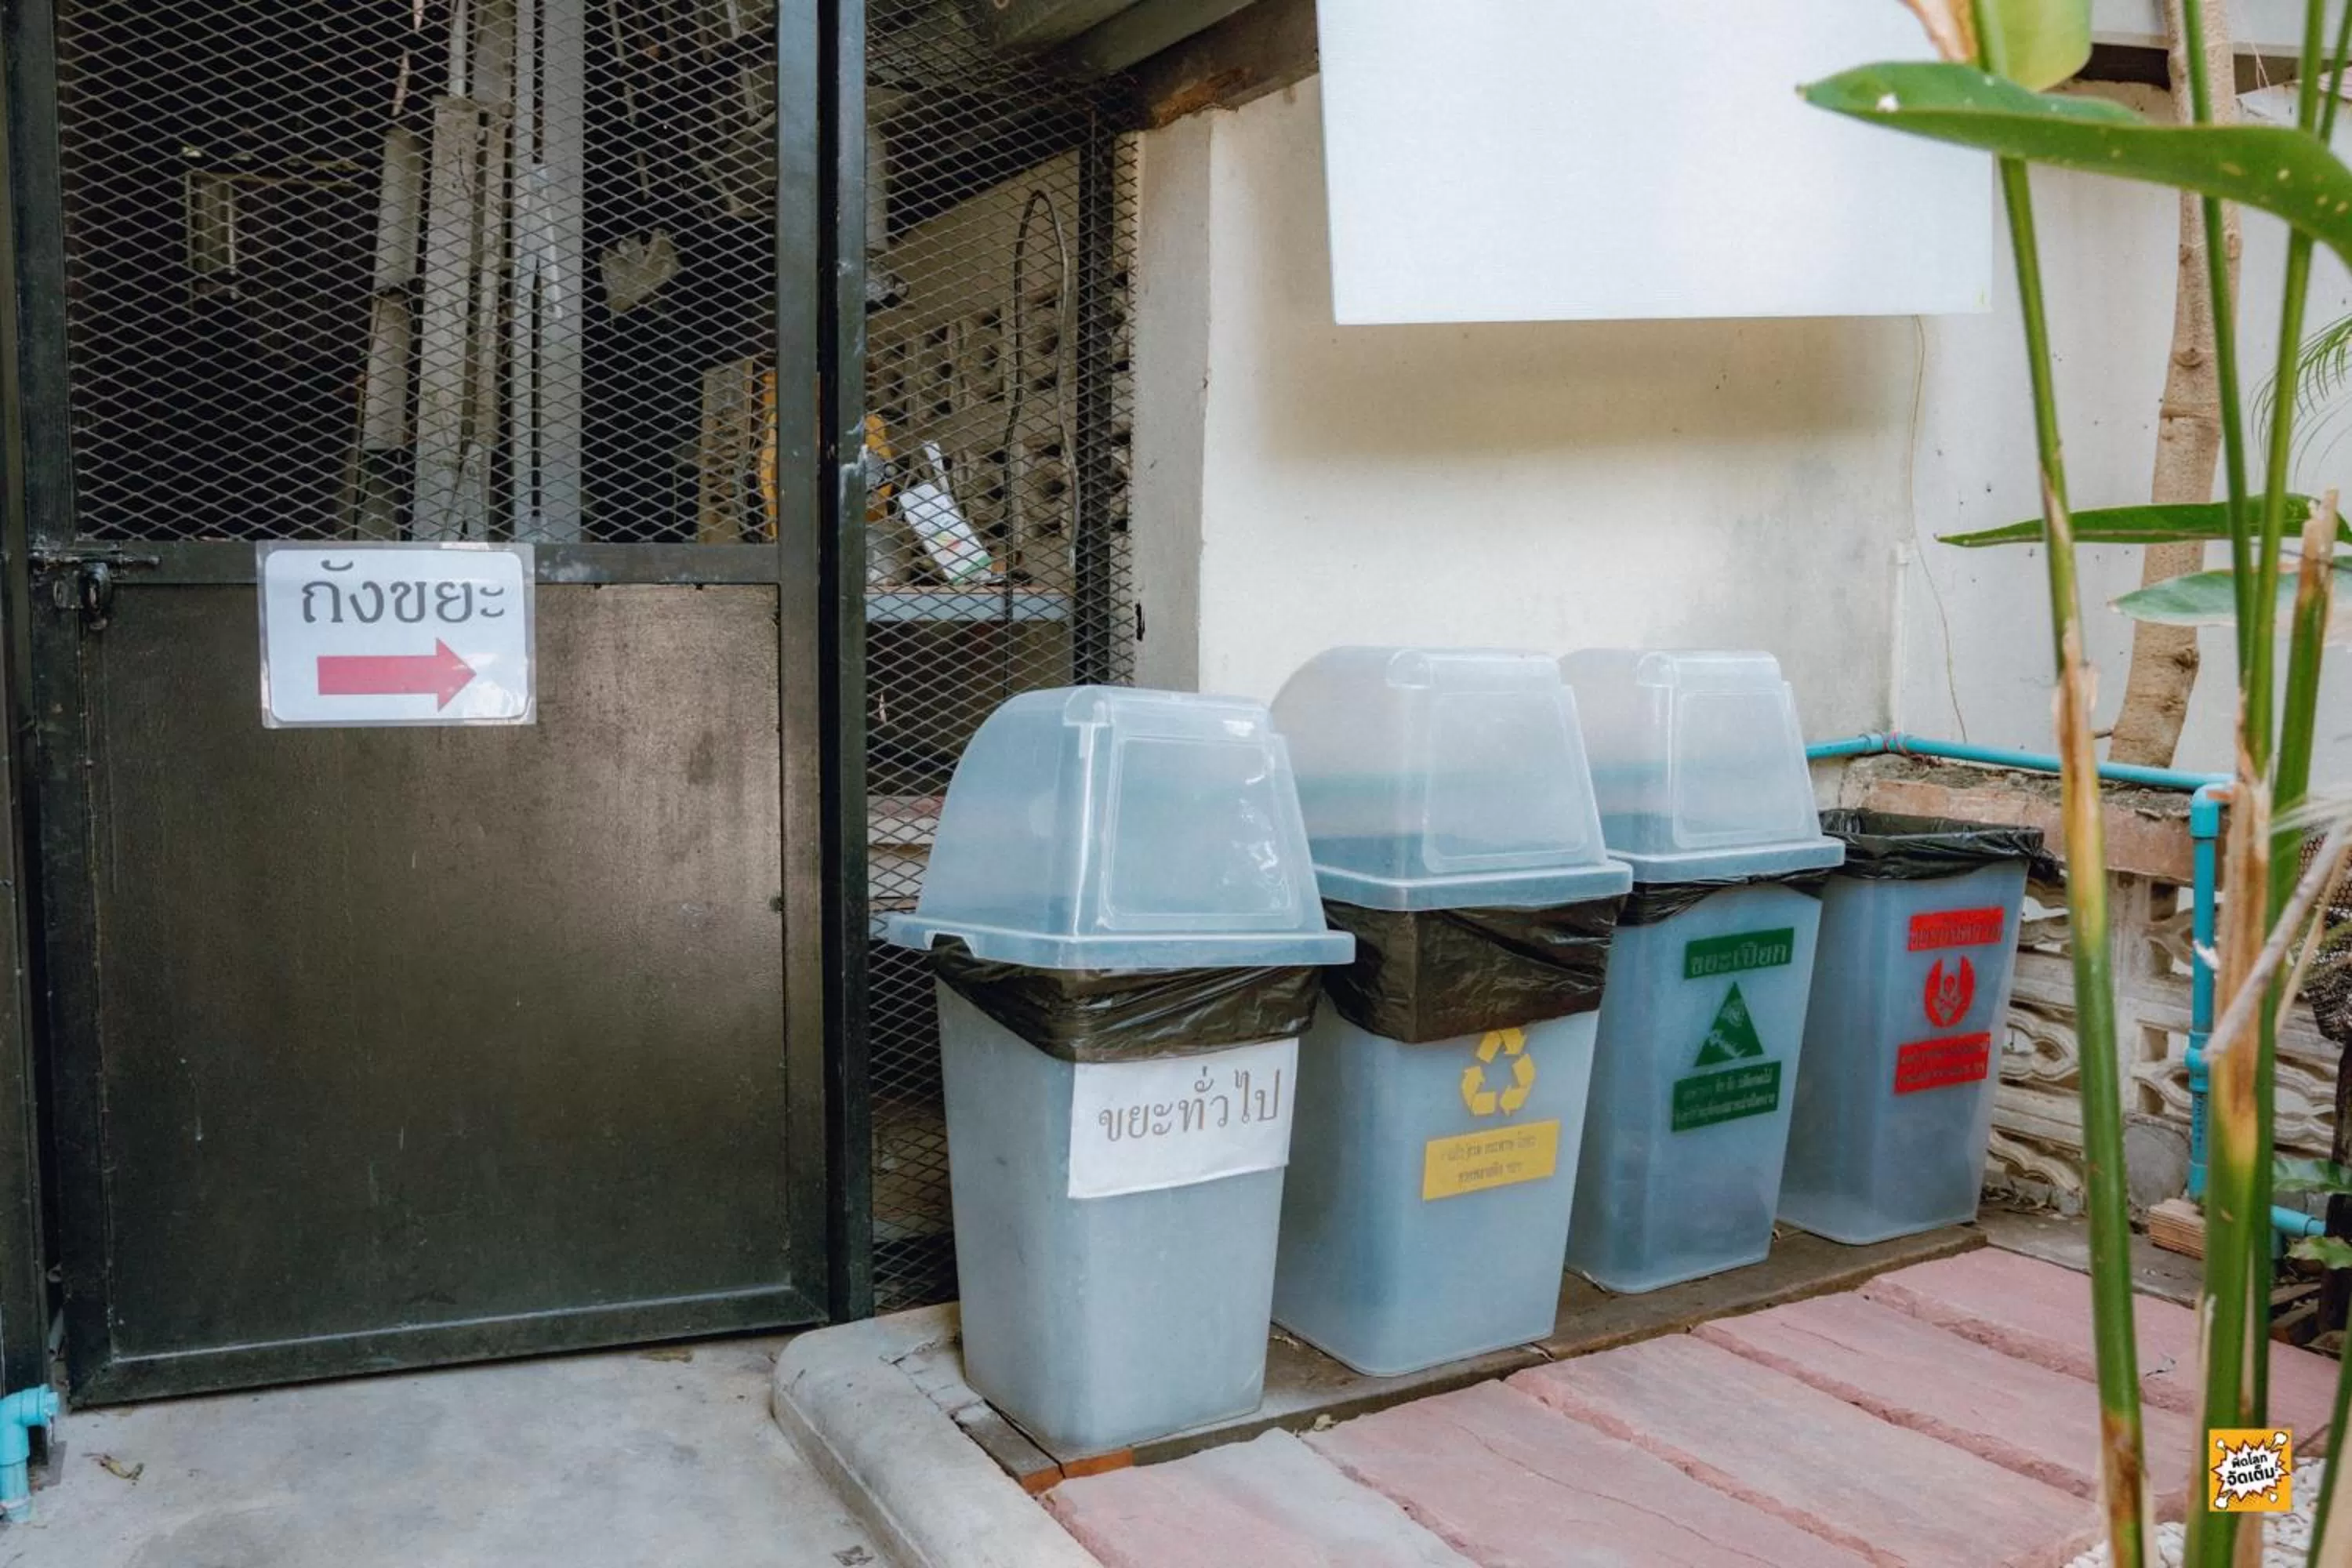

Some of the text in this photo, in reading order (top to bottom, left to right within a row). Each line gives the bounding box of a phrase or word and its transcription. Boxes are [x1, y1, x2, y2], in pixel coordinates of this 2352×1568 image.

[302, 560, 505, 623] ถังขยะ
[1098, 1066, 1281, 1142] ขยะทั่วไป
